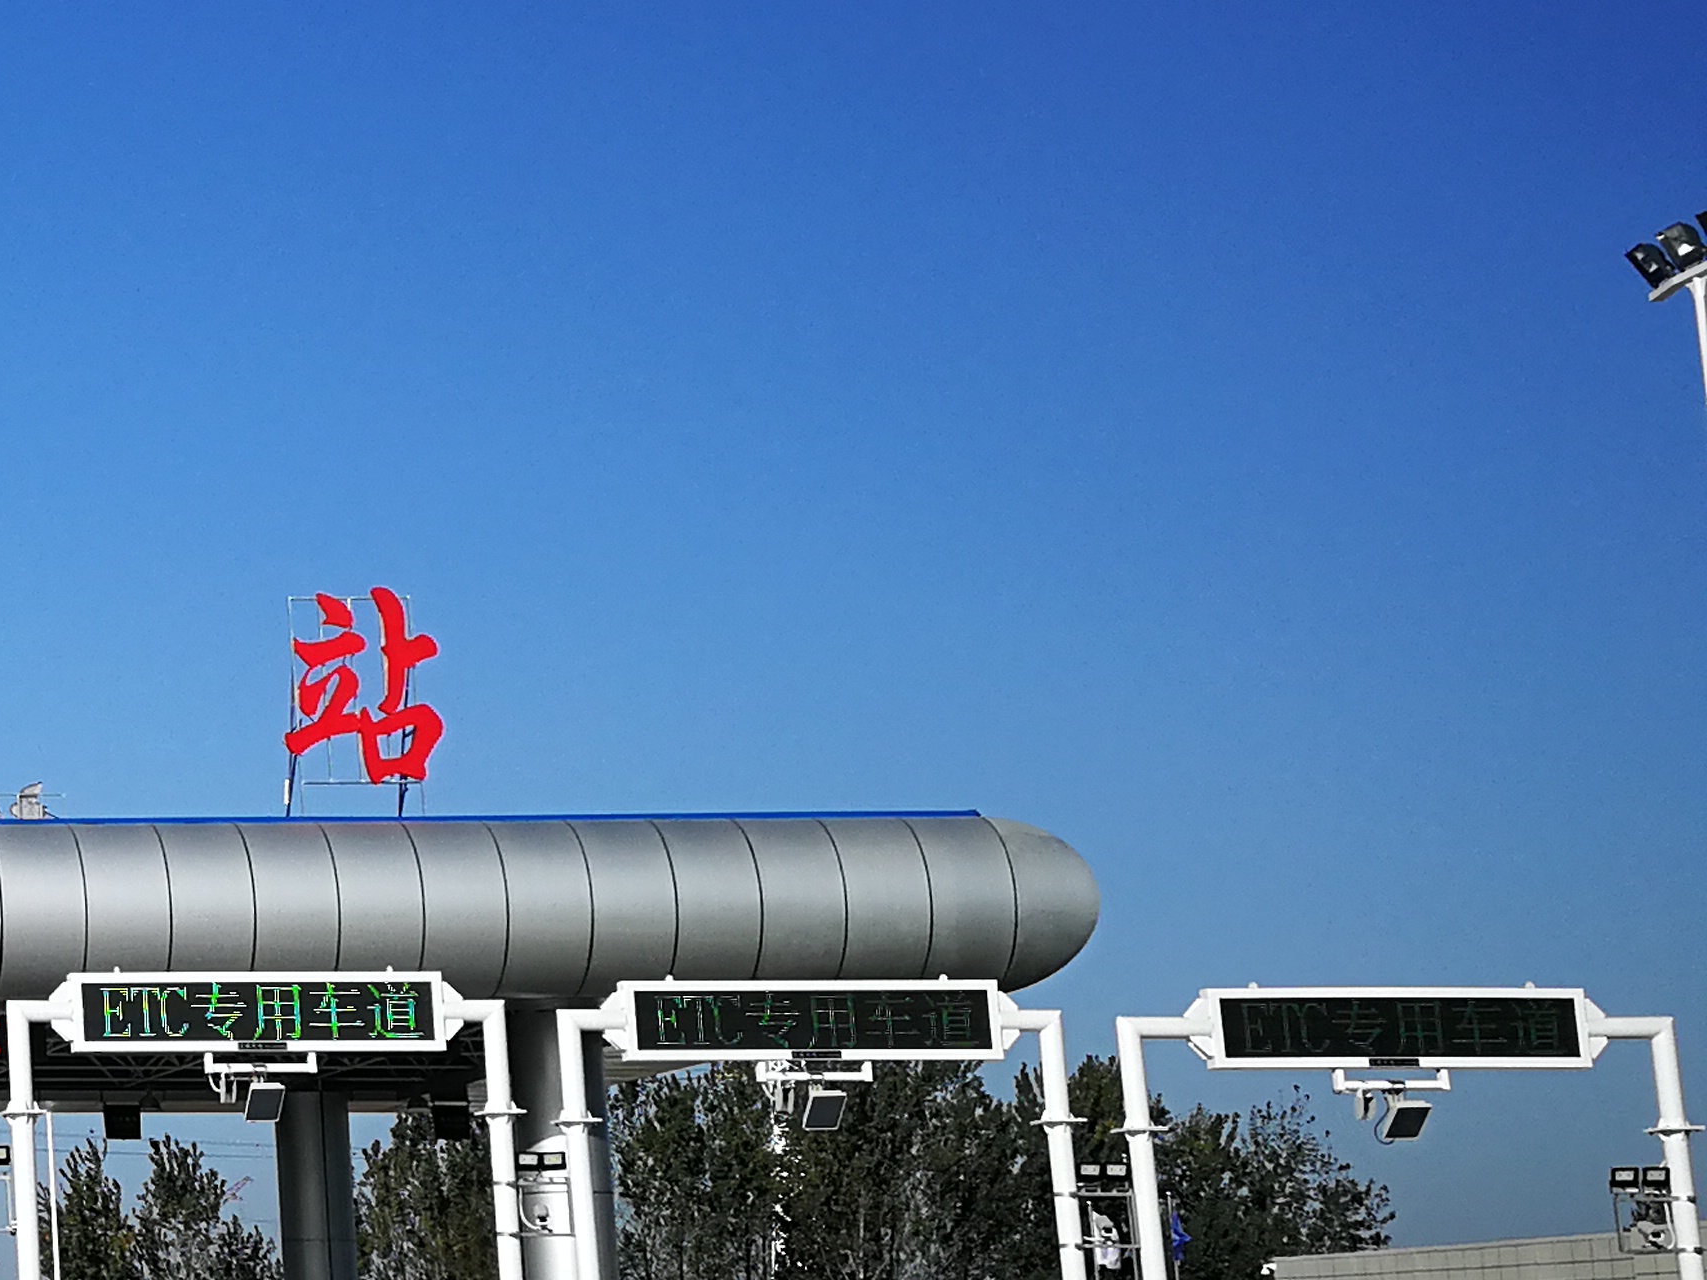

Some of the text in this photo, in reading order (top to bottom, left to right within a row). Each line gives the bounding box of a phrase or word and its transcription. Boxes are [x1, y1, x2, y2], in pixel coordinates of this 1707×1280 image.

[100, 982, 420, 1042] ETC专用车道
[654, 993, 973, 1050] ETC专用车道
[1241, 999, 1561, 1053] ETC专用车道
